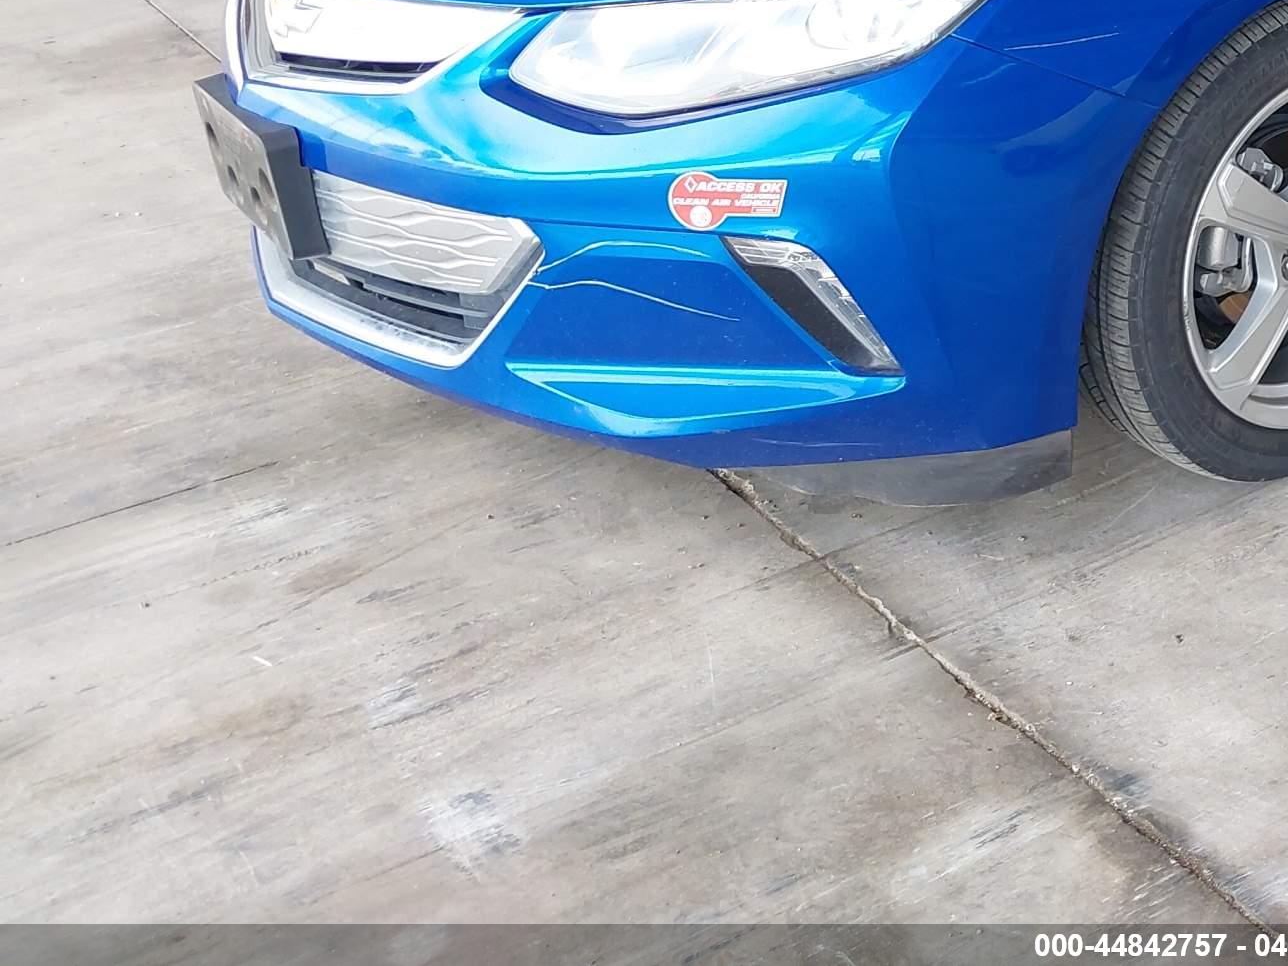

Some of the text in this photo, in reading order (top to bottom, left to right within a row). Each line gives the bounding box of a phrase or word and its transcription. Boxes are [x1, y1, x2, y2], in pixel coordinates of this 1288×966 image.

[696, 181, 783, 193] ACCESS OK
[672, 197, 780, 207] CLEAN AIR VEHICLE
